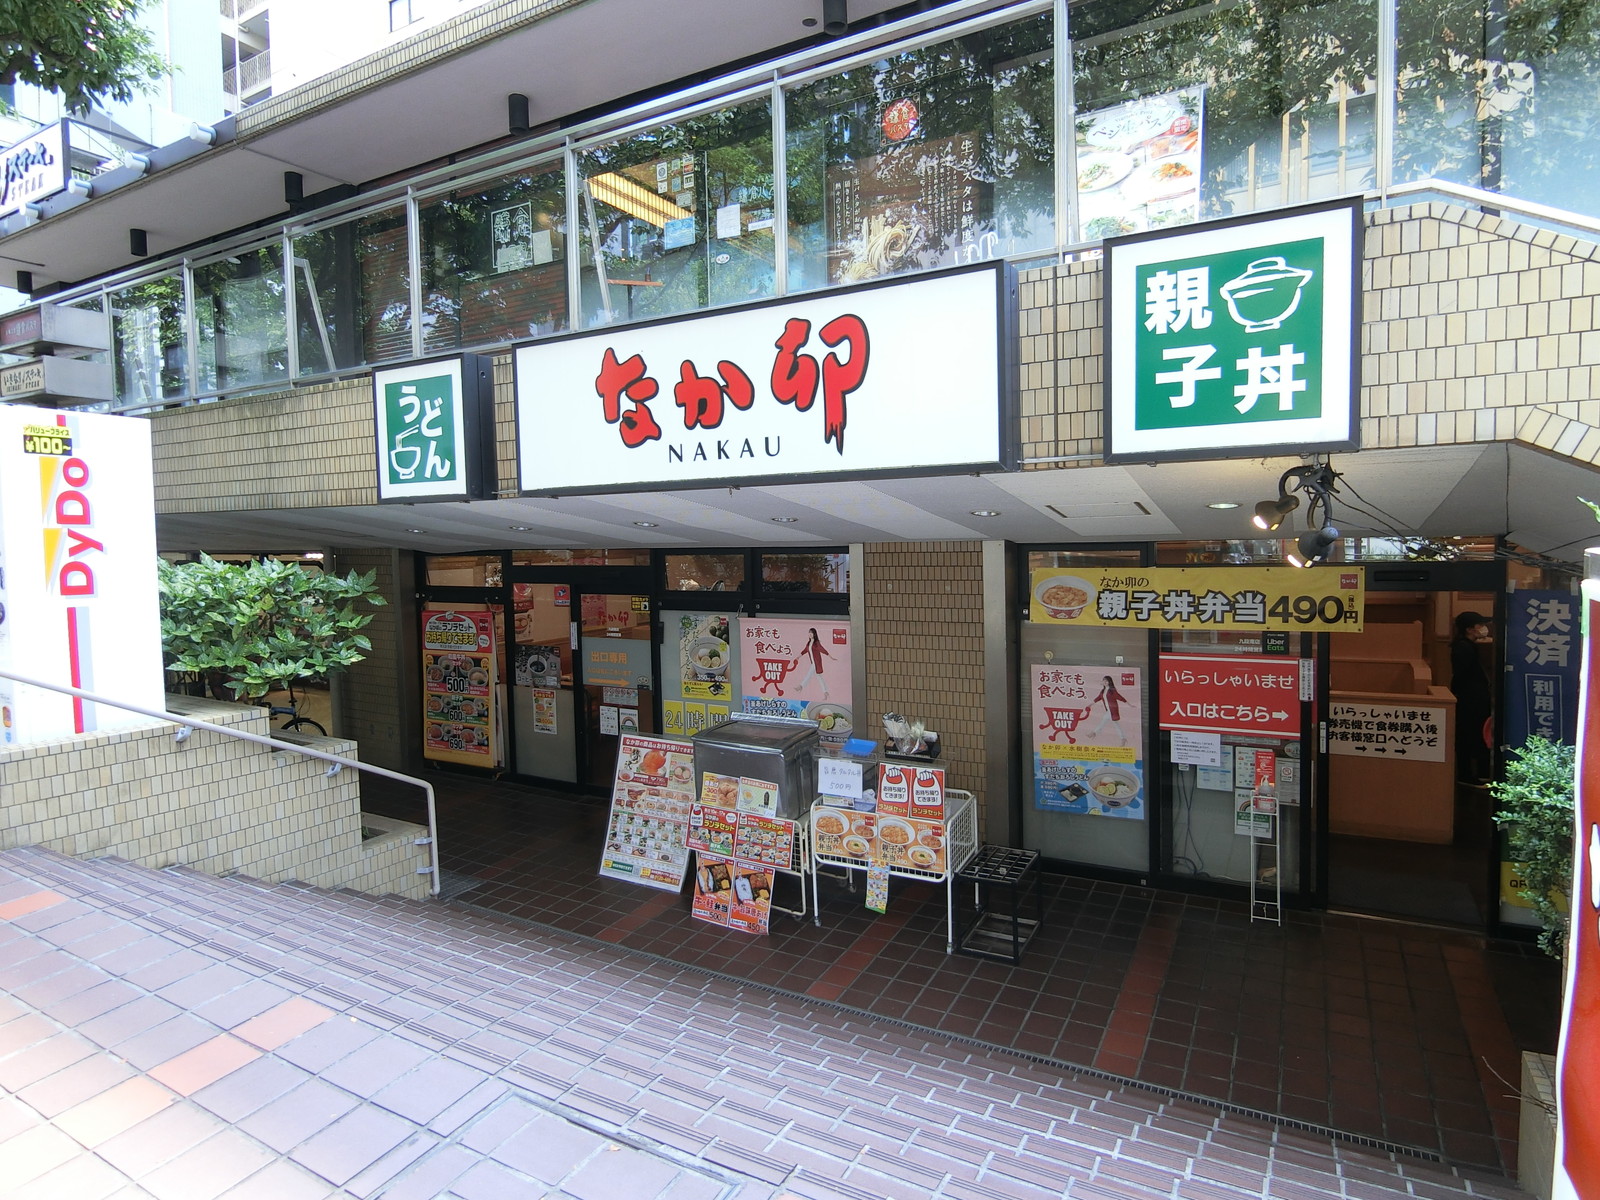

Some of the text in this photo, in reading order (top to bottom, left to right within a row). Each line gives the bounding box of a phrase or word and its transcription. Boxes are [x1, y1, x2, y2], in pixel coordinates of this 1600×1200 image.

[596, 313, 870, 456] なか卯
[398, 385, 451, 479] うどん
[668, 435, 780, 463] NAKAU
[56, 457, 104, 596] DyDo
[1100, 576, 1149, 588] なか卯の
[1098, 588, 1266, 625] 親子丼弁当
[745, 625, 781, 640] お家でも
[1524, 598, 1572, 667] 決済
[754, 641, 793, 656] 食べよう。
[763, 662, 783, 672] TAKE
[765, 671, 781, 681] OUT
[1039, 670, 1085, 686] お家でも
[1164, 669, 1295, 690] いらっしゃいませ
[1037, 684, 1088, 700] 食べよう。
[1052, 710, 1075, 721] TAKE
[1169, 700, 1270, 723] 入口はこちら
[1333, 706, 1432, 722] いらっしゃいませ
[1054, 720, 1073, 729] OUT
[1328, 718, 1439, 735] 券売機で食券購入後
[1328, 730, 1439, 747] お客様窓口へどうぞ
[829, 782, 852, 791] 500円
[883, 786, 907, 794] お持ち帰り
[916, 796, 939, 804] できます!
[878, 803, 908, 814] ランチセット
[912, 807, 943, 817] ランチセット
[704, 819, 735, 831] ランチセット
[759, 821, 785, 831] ランチセット
[818, 834, 841, 844] 親子丼
[818, 843, 833, 852] 弁当
[881, 844, 905, 854] 親子丼
[881, 853, 897, 862] 弁当
